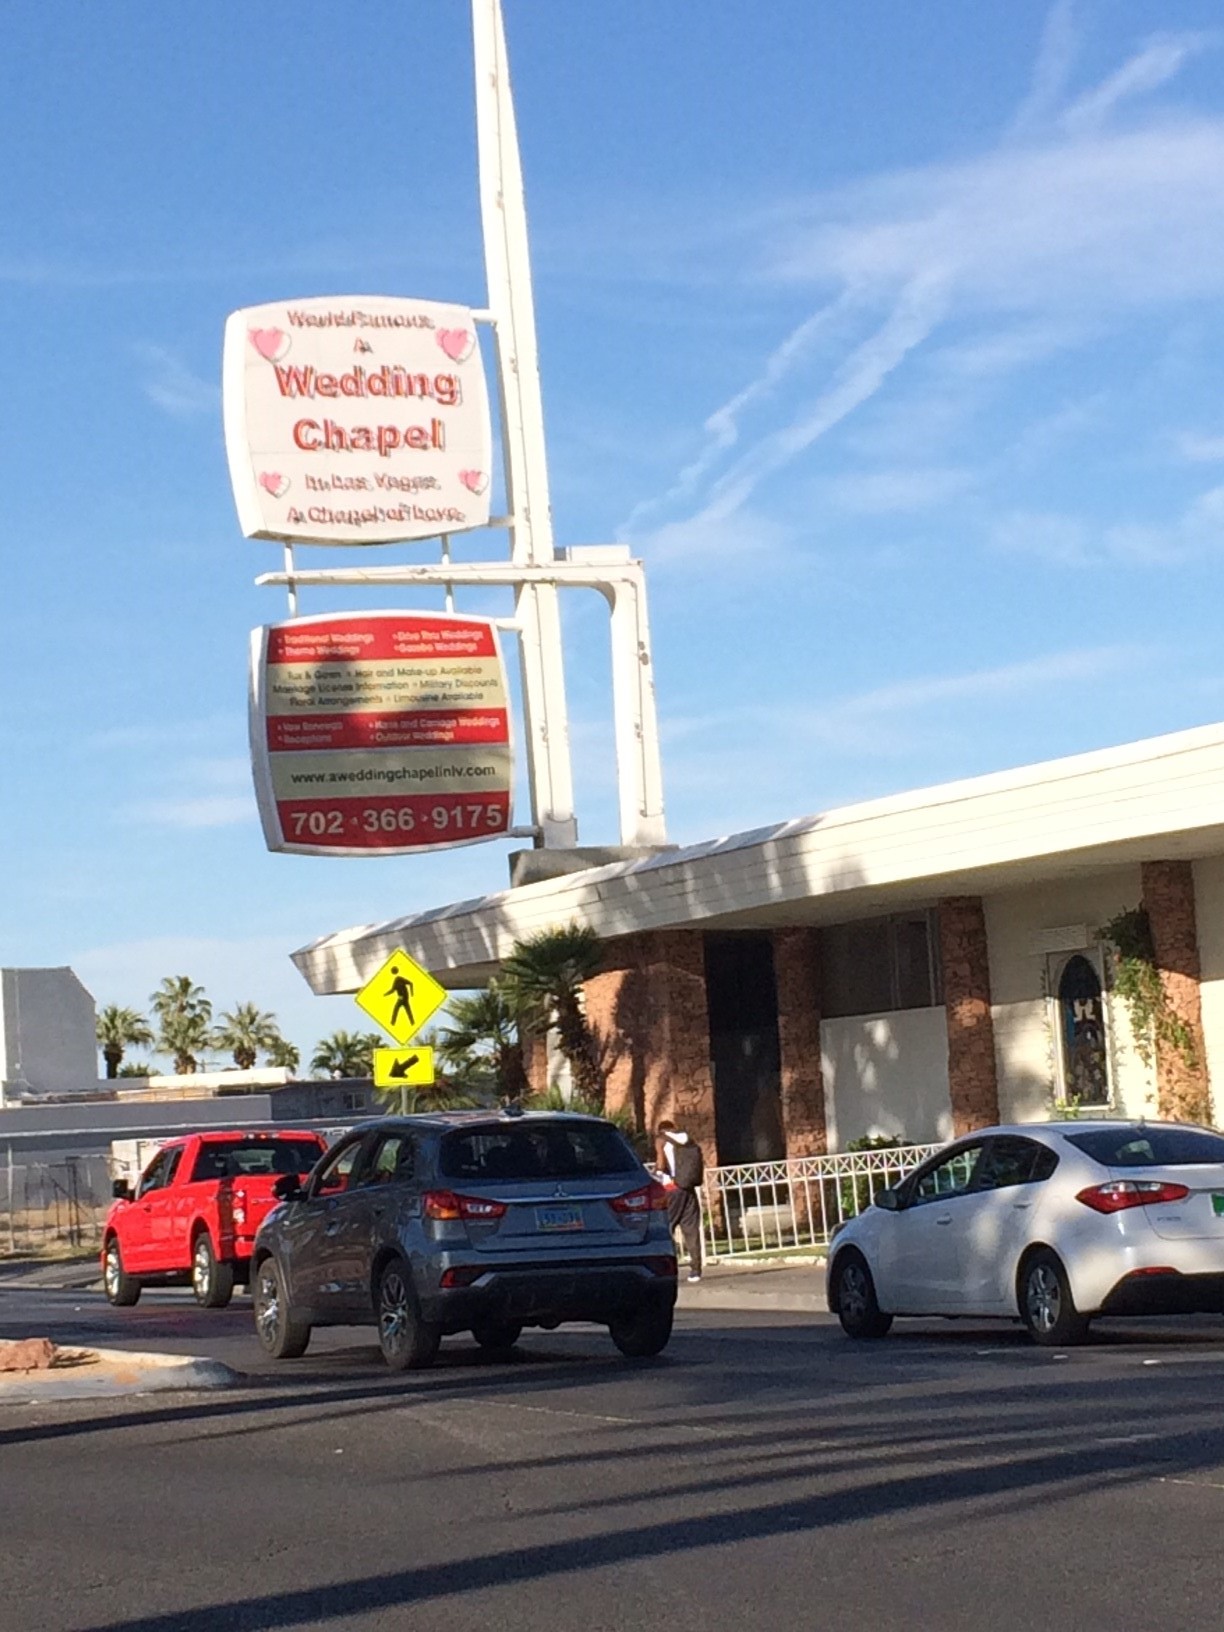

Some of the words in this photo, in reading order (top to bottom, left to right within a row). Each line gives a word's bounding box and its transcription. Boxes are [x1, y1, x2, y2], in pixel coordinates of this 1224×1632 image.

[275, 365, 463, 405] Wedding
[293, 418, 445, 458] Chapel
[374, 473, 441, 494] Vegas
[376, 668, 394, 678] and
[291, 765, 495, 783] www.aweddingchapelinlv.com
[291, 811, 344, 835] 702
[363, 808, 415, 832] 366
[431, 804, 502, 829] 9175
